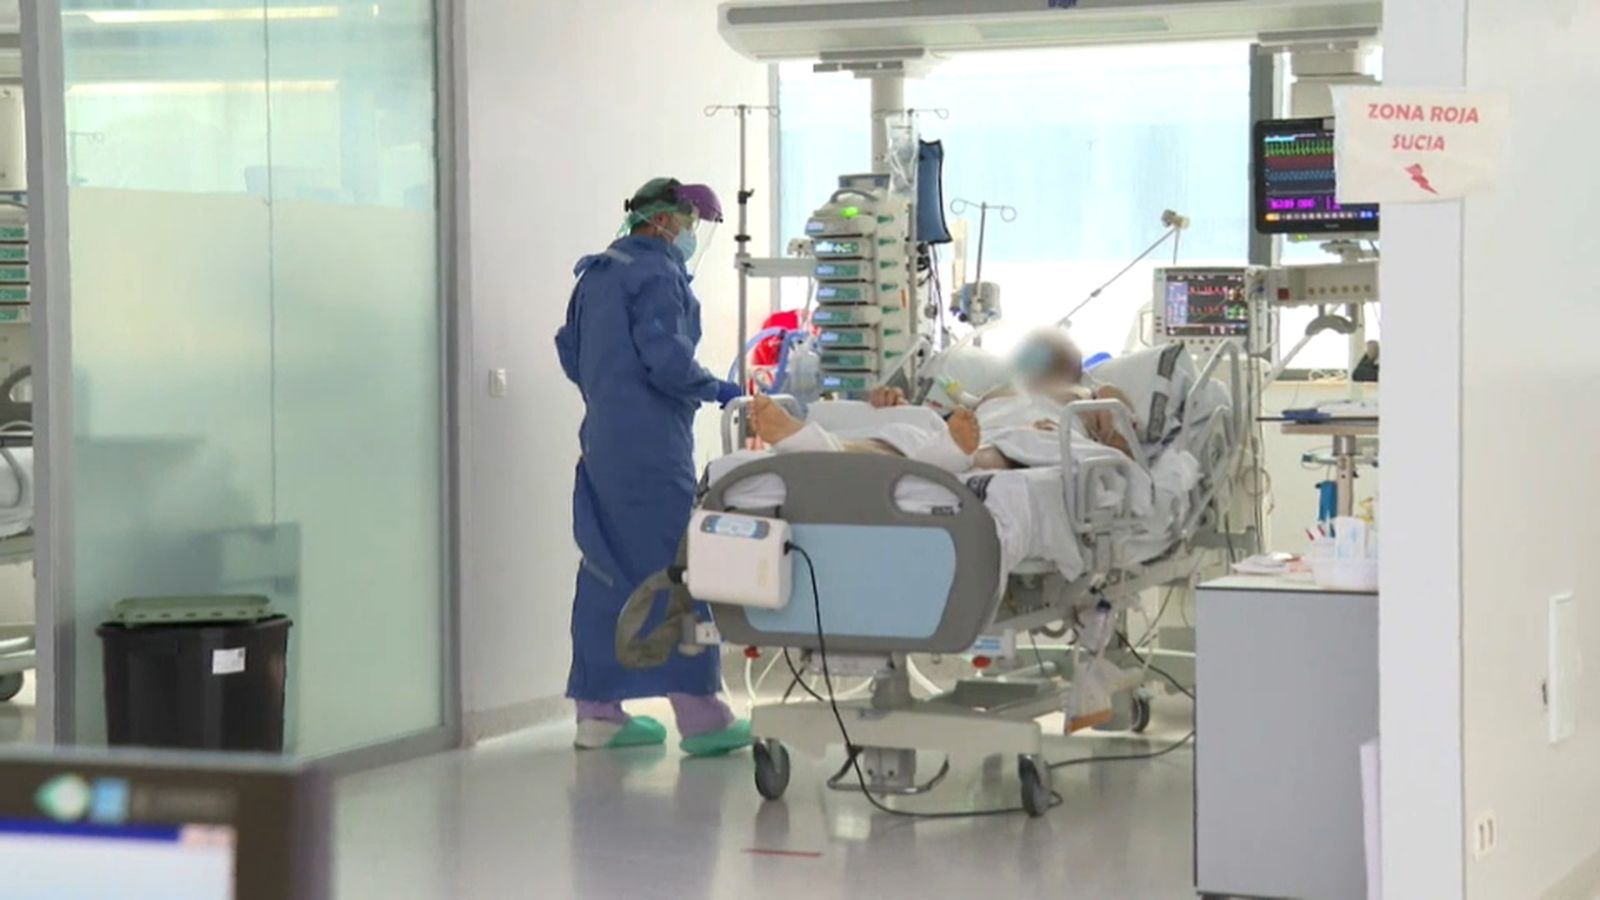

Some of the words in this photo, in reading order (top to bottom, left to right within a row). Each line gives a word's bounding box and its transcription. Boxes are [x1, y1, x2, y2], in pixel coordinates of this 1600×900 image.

[1368, 104, 1424, 121] ZONA
[1430, 105, 1478, 124] ROJA
[1392, 134, 1445, 151] SUCIA
